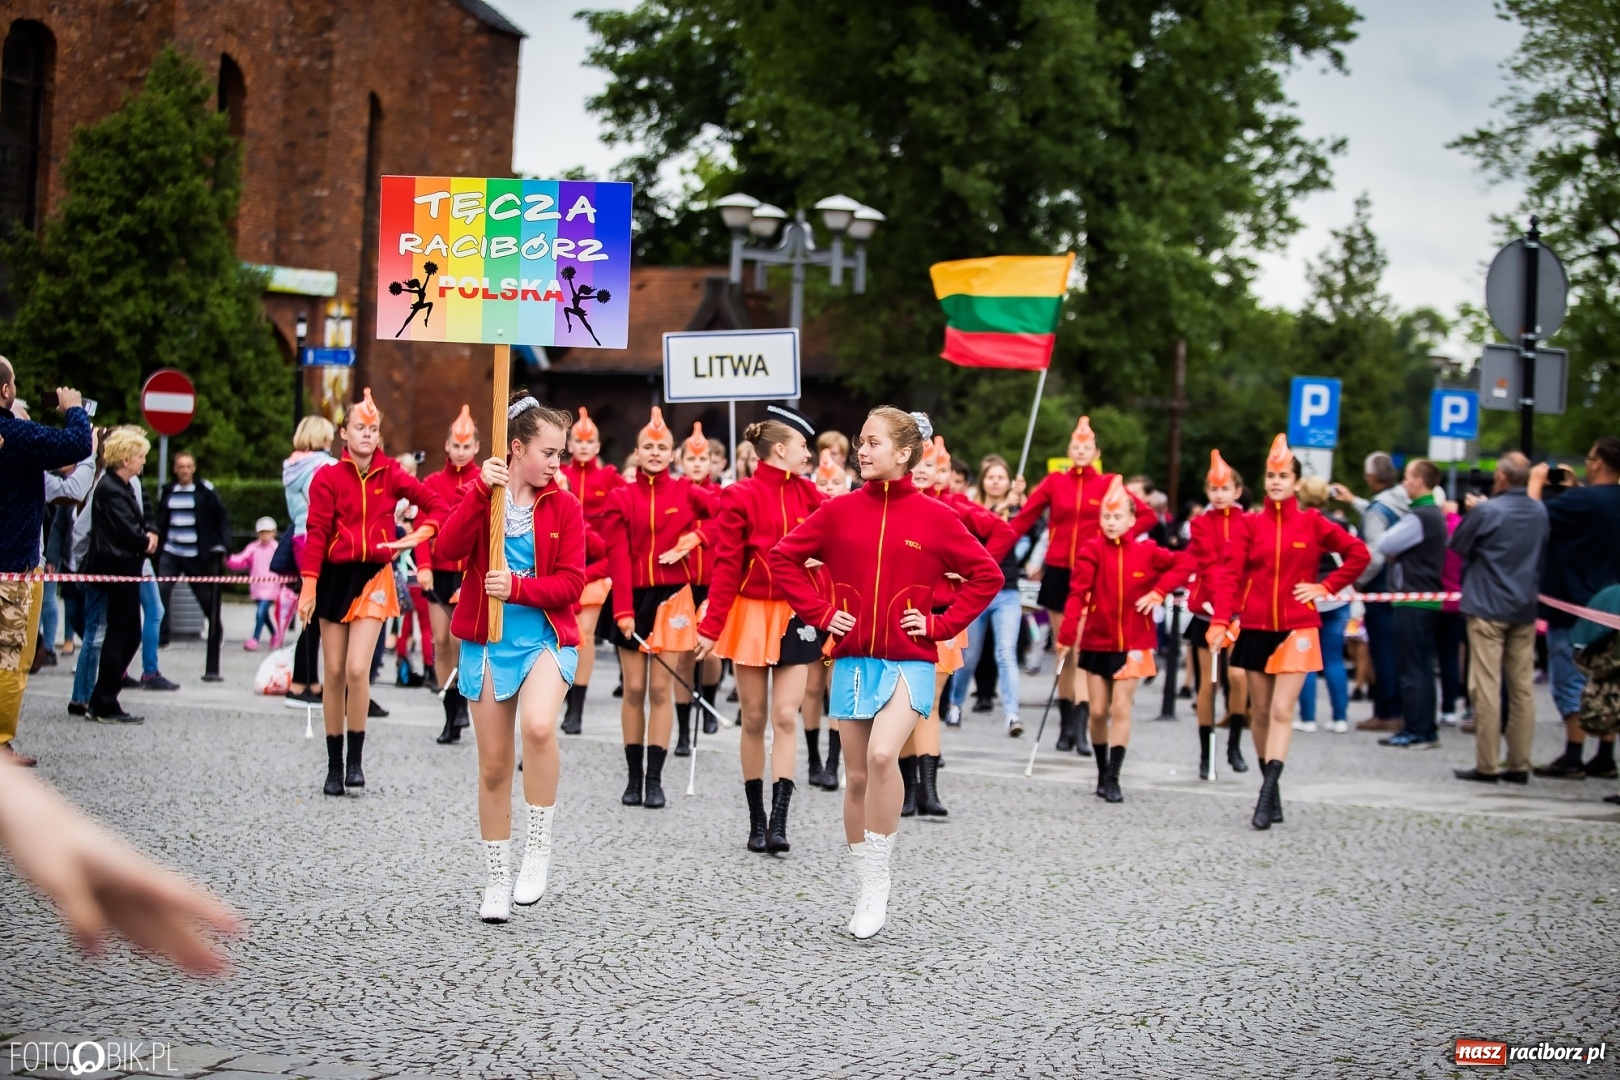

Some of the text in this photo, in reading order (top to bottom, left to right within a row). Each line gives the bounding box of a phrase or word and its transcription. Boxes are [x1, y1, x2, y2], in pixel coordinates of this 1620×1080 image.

[413, 190, 597, 225] TĘCZA
[398, 232, 610, 262] RACIBÓRZ
[438, 275, 566, 303] POLSKA
[694, 354, 769, 378] LITWA
[1300, 383, 1331, 427] P
[1440, 395, 1470, 433] P
